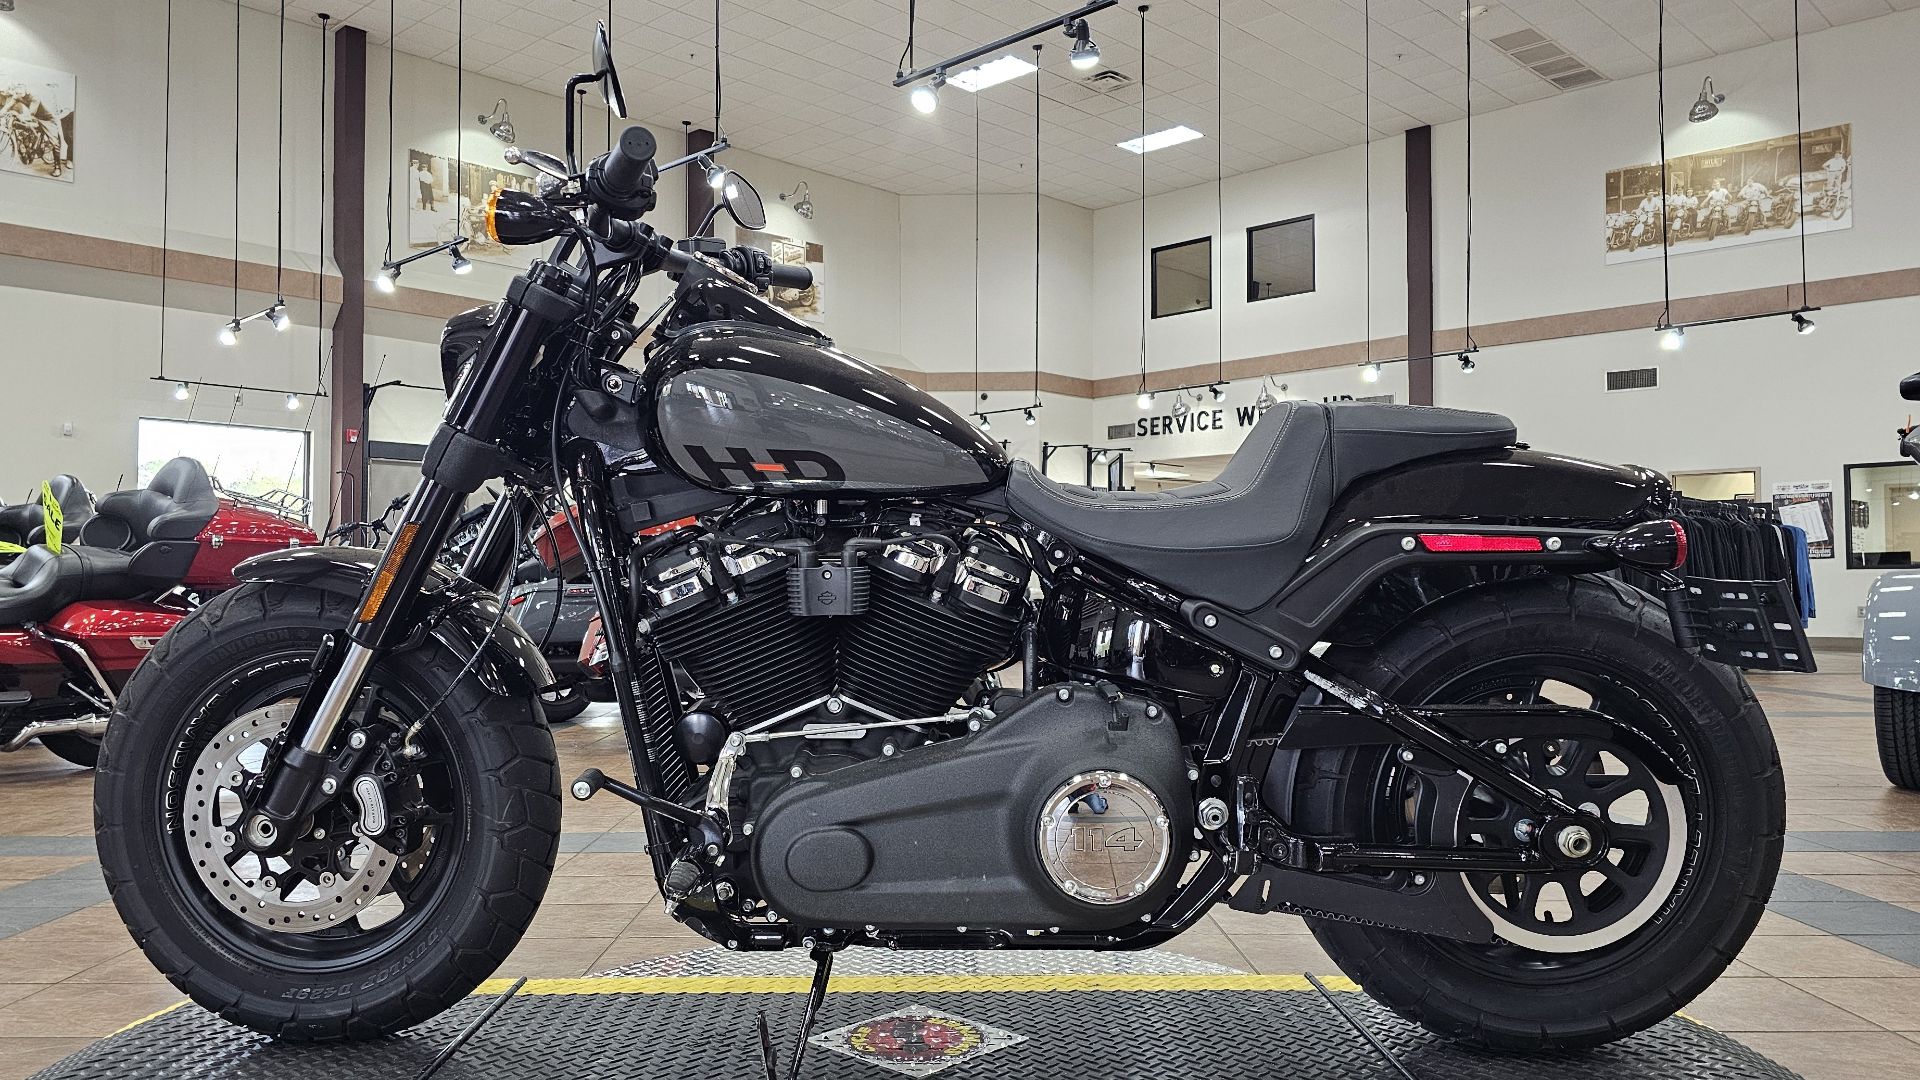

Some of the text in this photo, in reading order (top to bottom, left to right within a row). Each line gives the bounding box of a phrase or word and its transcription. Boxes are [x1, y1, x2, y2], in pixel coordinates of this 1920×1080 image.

[1137, 409, 1223, 437] SERVICE
[683, 445, 846, 489] H-D
[1070, 826, 1145, 852] 114
[360, 927, 439, 990] DUNLOP
